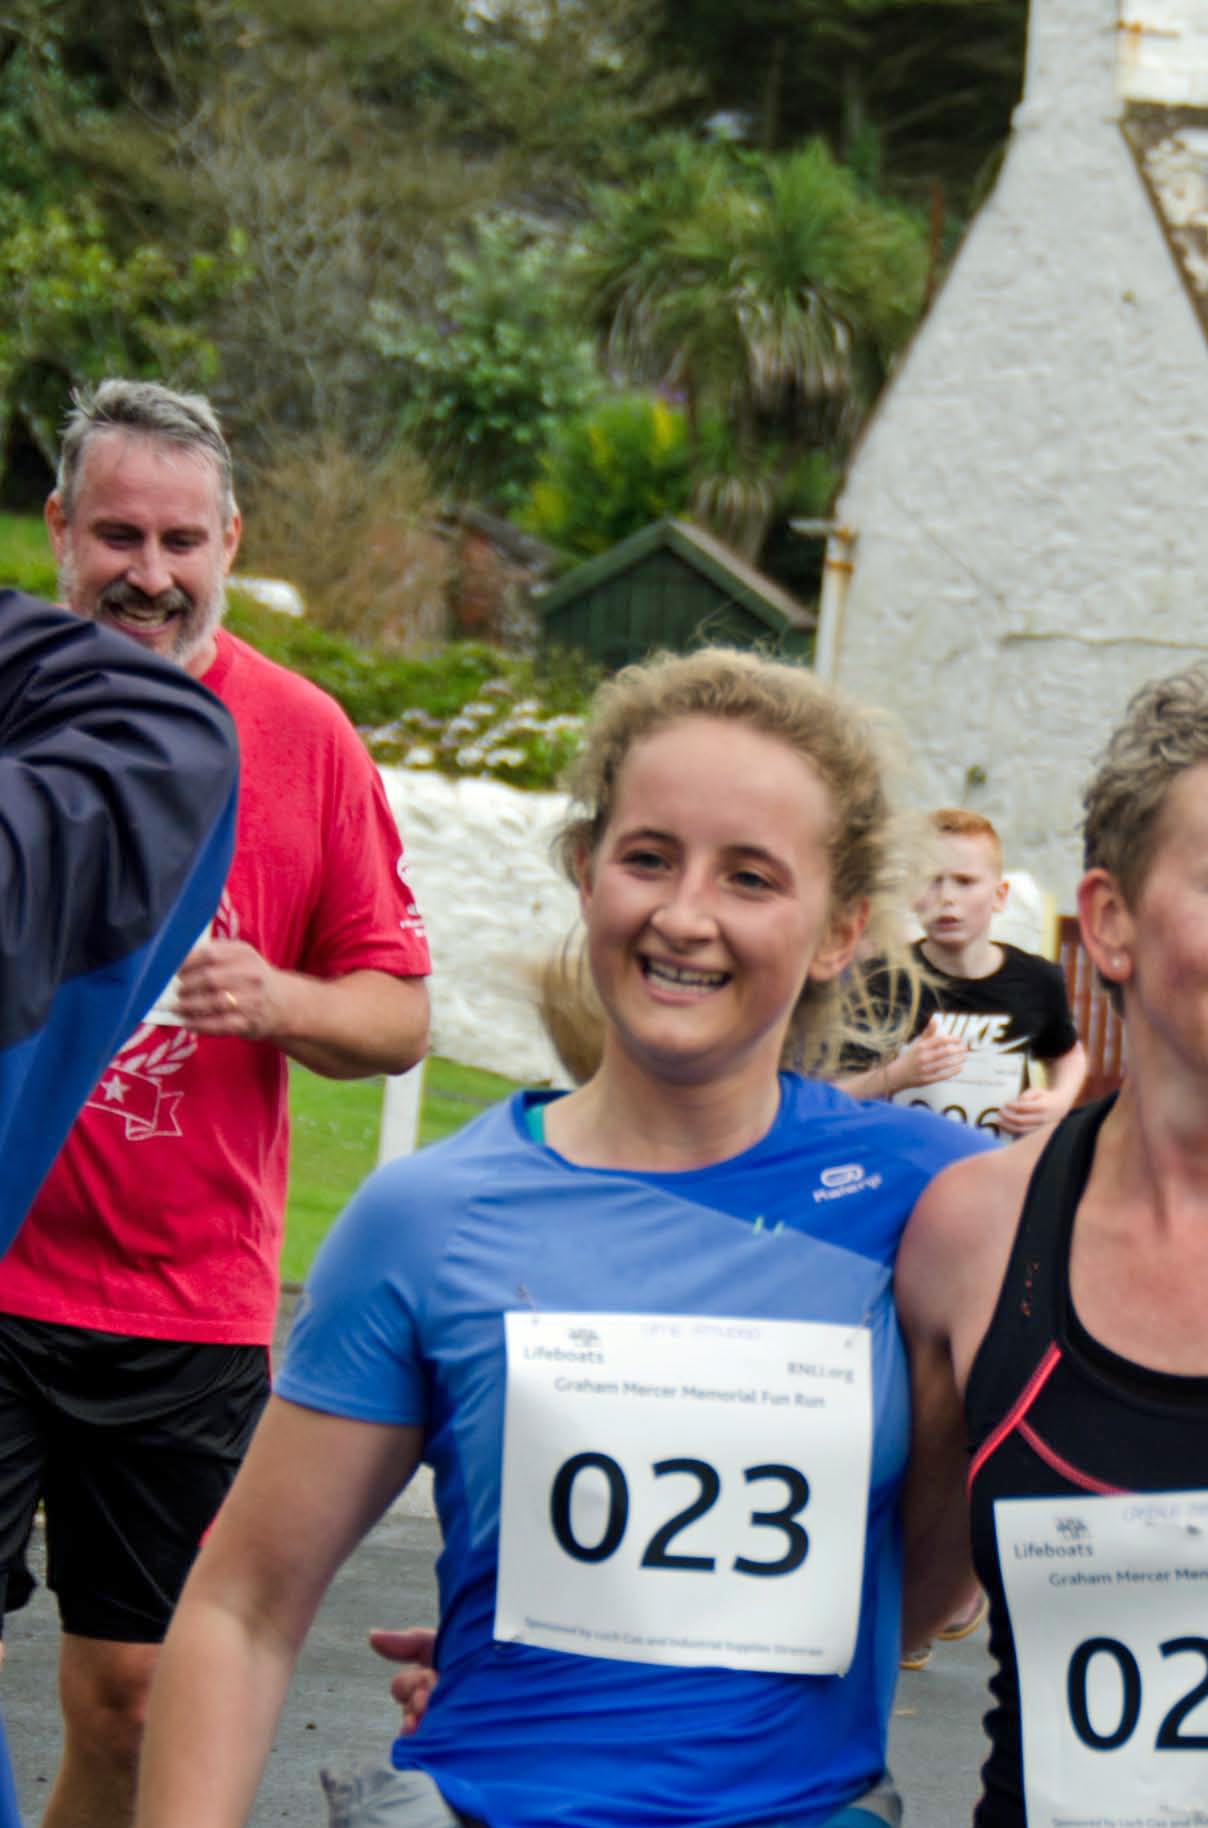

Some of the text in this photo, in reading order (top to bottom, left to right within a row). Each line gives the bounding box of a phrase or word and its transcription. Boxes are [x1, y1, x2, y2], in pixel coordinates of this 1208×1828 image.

[932, 1012, 1012, 1045] NIKE
[523, 1345, 605, 1364] Lifeboats
[553, 1376, 619, 1395] Graham
[680, 1385, 757, 1404] Memorial
[761, 1391, 790, 1406] Fun
[794, 1392, 825, 1408] Run
[549, 1451, 812, 1577] 023
[1013, 1542, 1094, 1560] Lifeboats
[1049, 1571, 1112, 1587] Graham
[1116, 1567, 1169, 1584] Mercer
